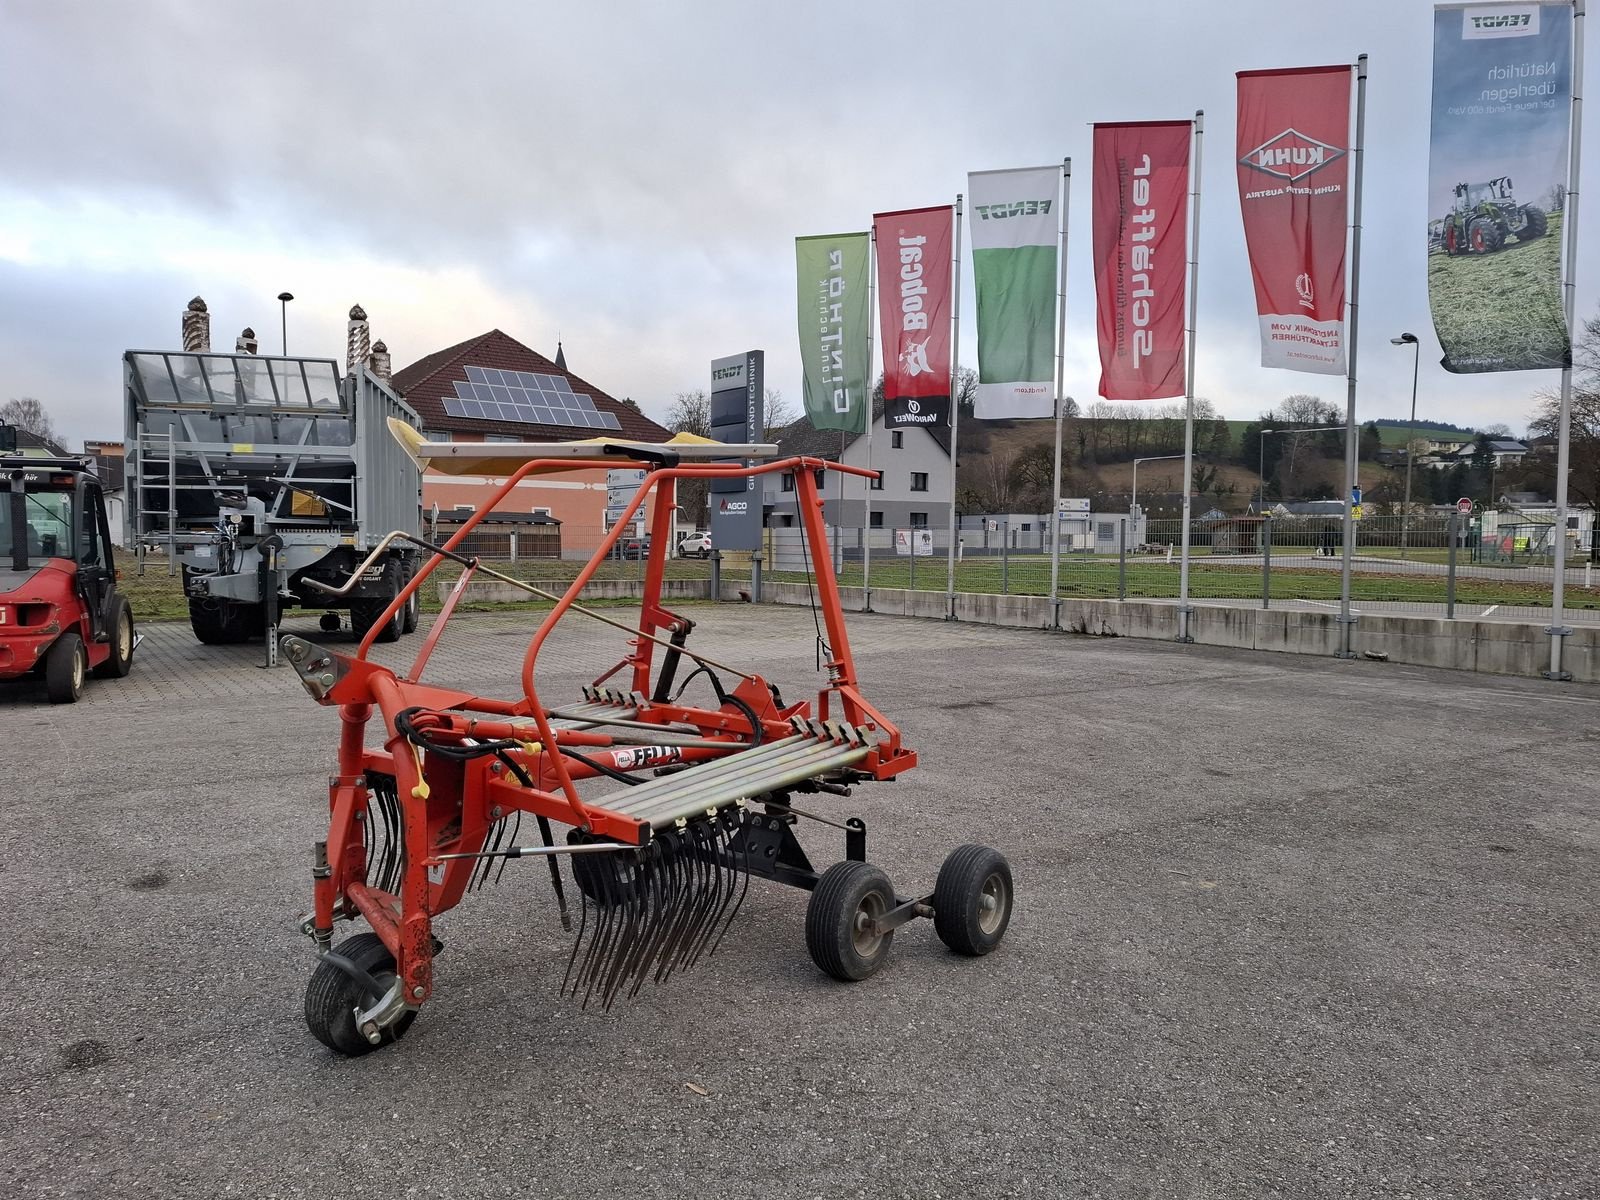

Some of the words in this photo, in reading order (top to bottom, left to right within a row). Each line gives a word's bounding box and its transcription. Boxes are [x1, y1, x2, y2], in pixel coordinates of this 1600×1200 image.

[713, 365, 744, 381] FENDT
[748, 357, 756, 437] LANDTECHNIK
[727, 502, 748, 510] AGCO
[1459, 502, 1470, 510] STOP
